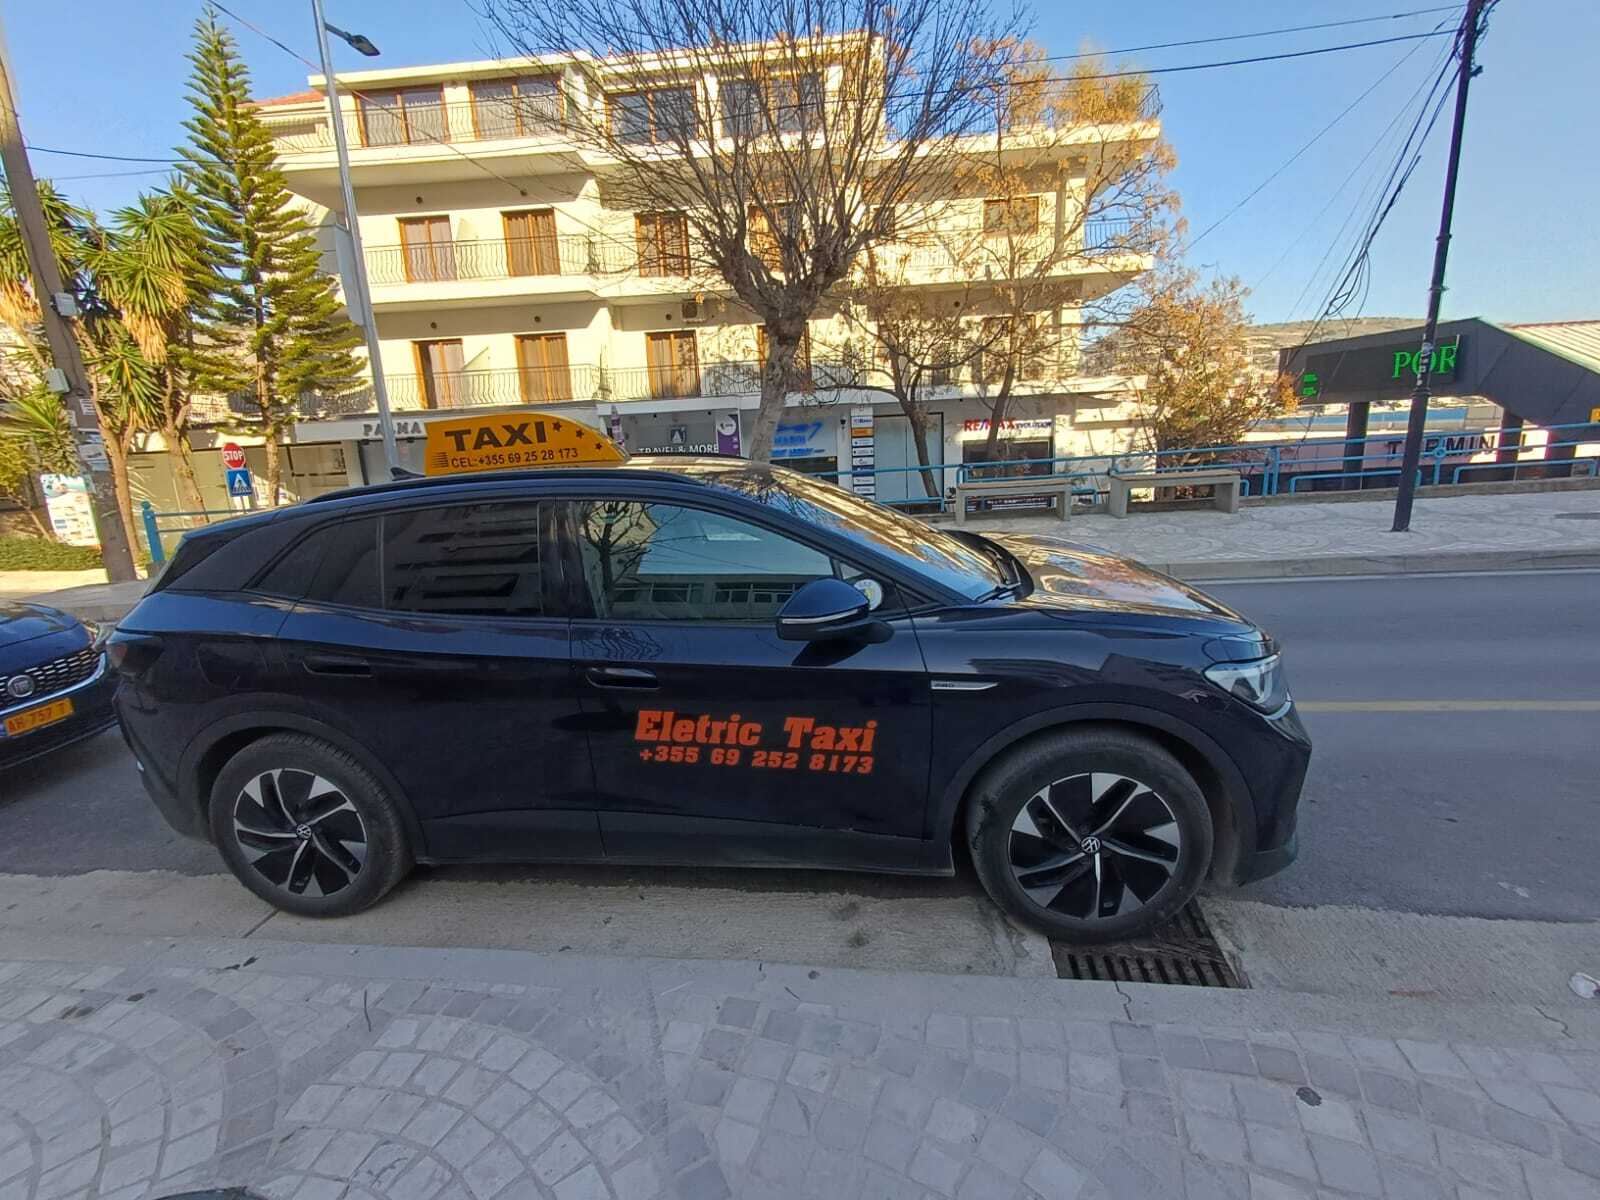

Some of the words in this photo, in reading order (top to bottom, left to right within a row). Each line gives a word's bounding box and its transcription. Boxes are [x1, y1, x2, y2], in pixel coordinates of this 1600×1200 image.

[363, 421, 422, 437] PAMA
[444, 421, 547, 452] TAXI
[223, 450, 243, 461] STOP
[508, 453, 521, 464] 69
[525, 451, 538, 463] 25
[541, 449, 554, 461] 28
[558, 447, 579, 459] 173
[689, 443, 720, 453] MORE
[1386, 433, 1534, 462] TRMINL
[635, 710, 762, 746] Eletric
[784, 717, 878, 752] Taxi
[640, 745, 699, 763] +355
[711, 748, 740, 765] 69
[751, 750, 799, 769] 252
[809, 754, 873, 774] 8173
